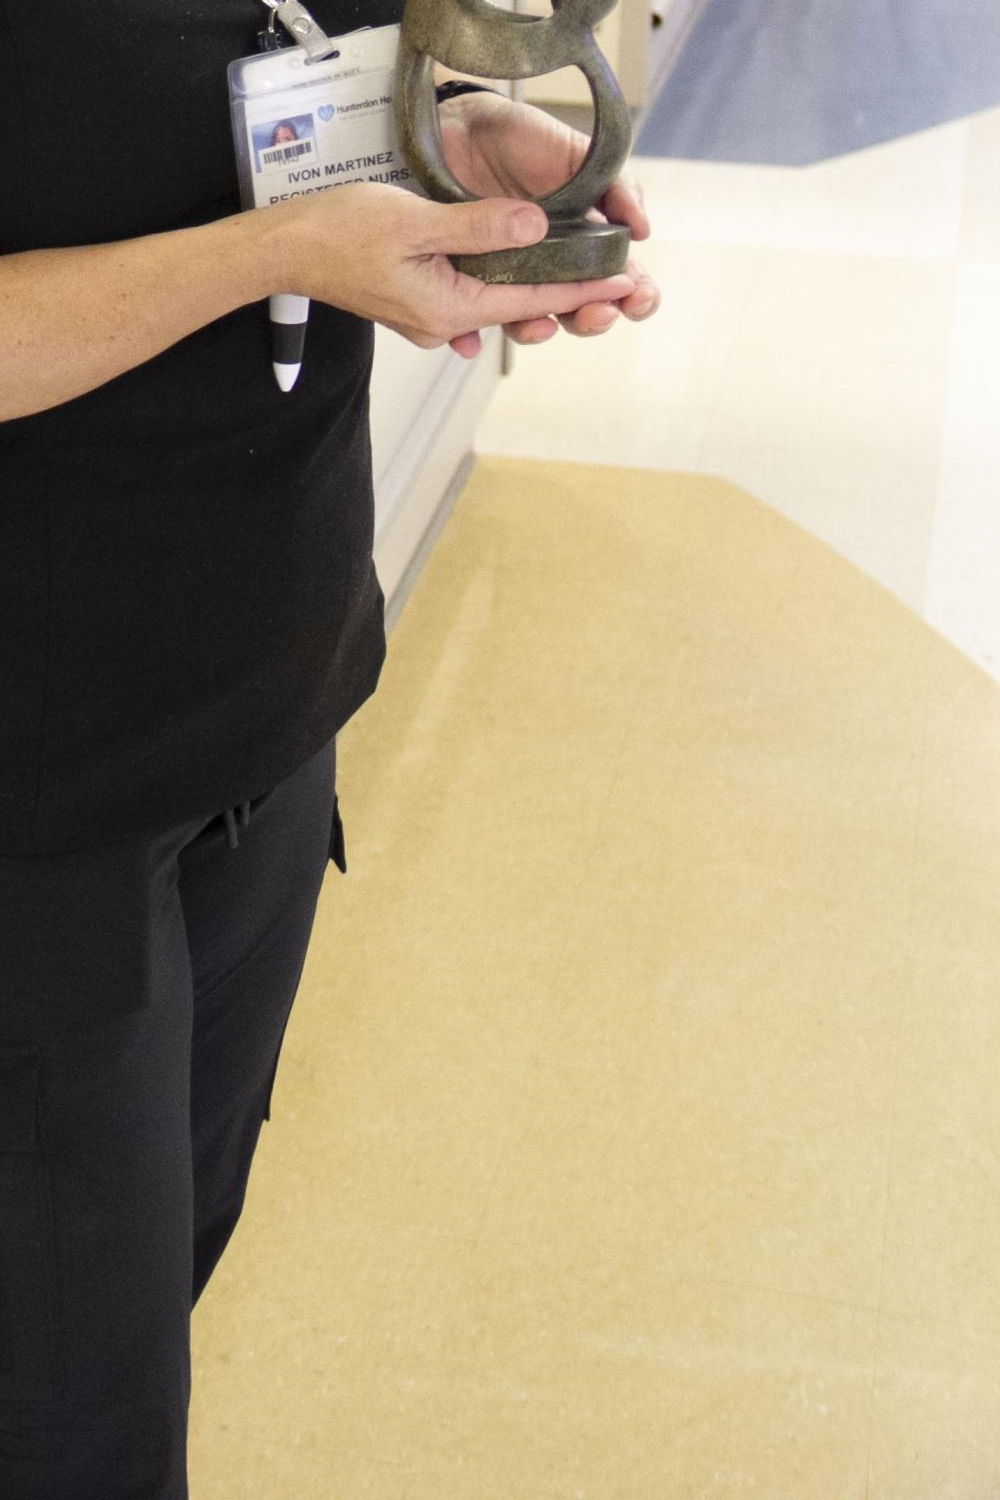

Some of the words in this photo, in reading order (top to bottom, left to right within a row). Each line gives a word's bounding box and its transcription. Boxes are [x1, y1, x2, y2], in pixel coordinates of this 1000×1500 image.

[336, 99, 379, 114] Hunterdon
[379, 95, 392, 105] He
[288, 168, 321, 184] IVON
[324, 151, 394, 176] MARTINEZ
[368, 167, 410, 184] NURS
